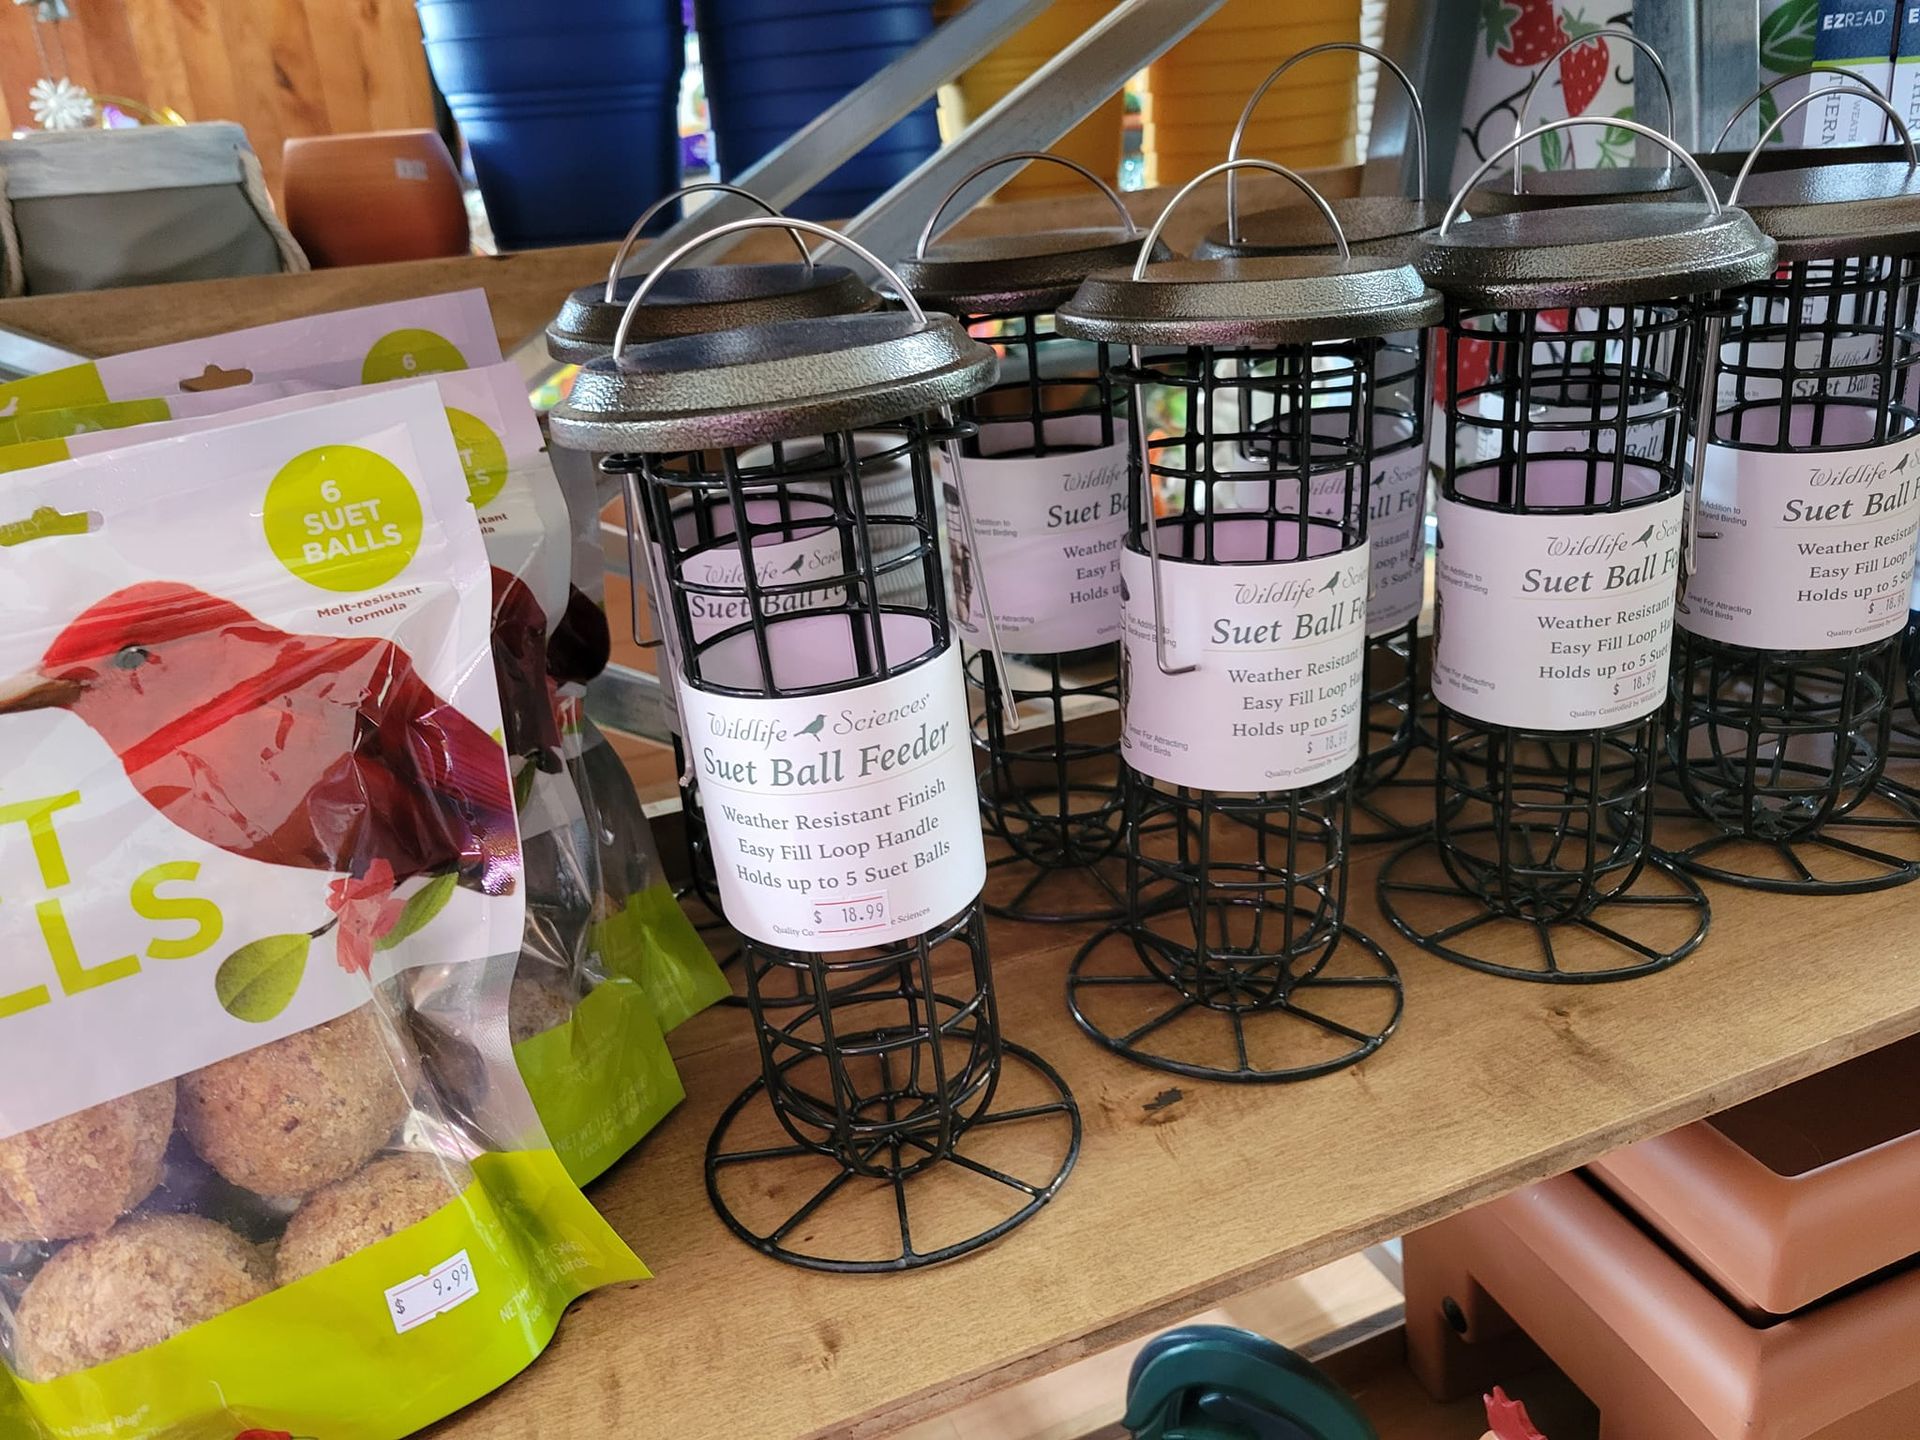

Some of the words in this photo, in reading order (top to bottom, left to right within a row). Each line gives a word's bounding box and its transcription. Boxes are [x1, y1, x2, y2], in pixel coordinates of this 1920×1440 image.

[1823, 9, 1885, 31] EZREAD
[402, 354, 416, 370] 6
[1063, 464, 1121, 491] Wildlife
[1809, 462, 1888, 488] Wildlife
[320, 479, 341, 503] 6
[1783, 499, 1854, 522] Suet
[1863, 479, 1911, 517] Ball
[303, 499, 381, 536] SUET
[1048, 501, 1101, 528] Suet
[302, 523, 402, 565] BALLS
[1063, 538, 1118, 560] Weather
[1547, 532, 1628, 560] Wildlife
[1797, 540, 1870, 556] Weather
[1076, 564, 1106, 580] Easy
[1522, 569, 1594, 594] Suet
[1603, 554, 1657, 590] Ball
[1810, 566, 1850, 581] Easy
[1854, 559, 1878, 575] Fill
[1883, 550, 1908, 569] Loop
[1070, 587, 1109, 604] Holds
[1234, 578, 1315, 609] Wildlife
[1797, 590, 1848, 602] Holds
[1854, 586, 1872, 600] up
[1877, 581, 1889, 593] to
[1891, 575, 1898, 588] 5
[317, 586, 422, 619] Melt-resistant
[347, 603, 407, 626] formula
[691, 595, 750, 619] Suet
[1211, 618, 1282, 645] Suet
[1292, 602, 1344, 641] Ball
[1538, 615, 1611, 629] Weather
[1826, 628, 1853, 638] Quality
[1550, 641, 1591, 657] Easy
[1597, 635, 1622, 652] Fill
[1628, 628, 1657, 646] Loop
[1228, 668, 1302, 683] Weather
[1539, 665, 1591, 679] Holds
[1597, 665, 1617, 679] up
[1622, 660, 1635, 672] to
[1639, 654, 1646, 667] 5
[1613, 682, 1620, 696] $
[1632, 670, 1657, 692] 18.99
[1243, 696, 1284, 712] Easy
[1289, 690, 1314, 707] Fill
[1319, 682, 1347, 701] Loop
[1232, 723, 1284, 737] Holds
[1290, 721, 1309, 736] up
[1314, 715, 1328, 728] to
[1331, 708, 1337, 722] 5
[1570, 708, 1597, 719] Quality
[707, 711, 788, 750] Wildlife
[703, 746, 758, 785] Suet
[770, 749, 845, 787] Ball
[858, 720, 950, 778] Feeder
[1307, 741, 1313, 754] $
[1265, 768, 1292, 779] Quality
[721, 804, 789, 831] Weather
[796, 803, 893, 830] Resistant
[897, 778, 946, 812] Finish
[738, 838, 775, 863] Easy
[781, 845, 812, 860] Fill
[819, 841, 870, 859] Loop
[876, 815, 939, 850] Handle
[736, 864, 782, 889] Holds
[788, 879, 812, 895] up
[819, 876, 838, 890] to
[846, 871, 857, 886] 5
[865, 860, 909, 883] Suet
[914, 839, 951, 869] Balls
[772, 924, 800, 937] Quality
[897, 907, 931, 923] Sciences
[814, 909, 823, 924] $
[841, 901, 885, 924] 18.99
[395, 1298, 406, 1315] $
[432, 1263, 470, 1297] 9.99
